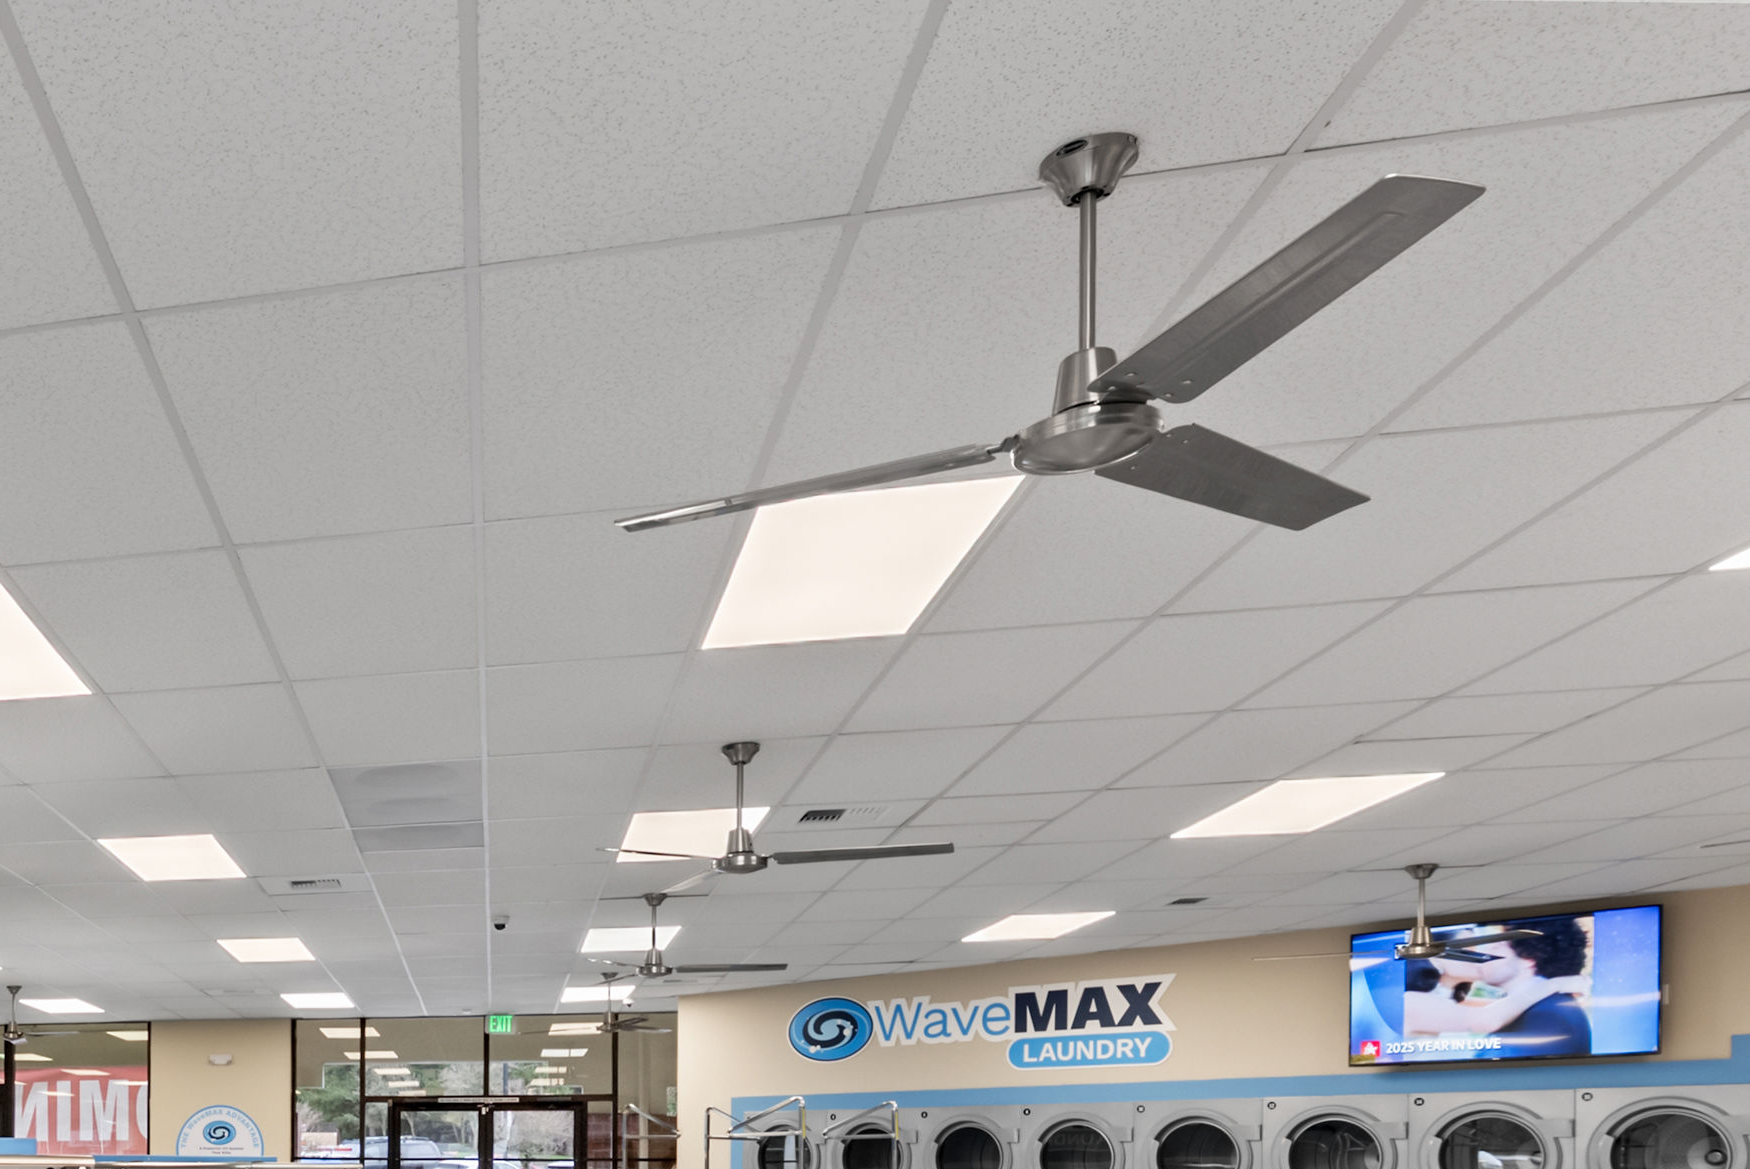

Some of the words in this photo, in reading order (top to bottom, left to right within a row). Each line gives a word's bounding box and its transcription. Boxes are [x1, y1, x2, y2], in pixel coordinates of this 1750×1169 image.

[874, 982, 1163, 1041] WaveMAX
[490, 1015, 513, 1033] EXIT
[1023, 1037, 1152, 1064] LAUNDRY
[1386, 1042, 1414, 1054] 2025
[1416, 1040, 1449, 1053] YEAR
[1452, 1039, 1465, 1051] IN
[1466, 1037, 1501, 1050] LOVE
